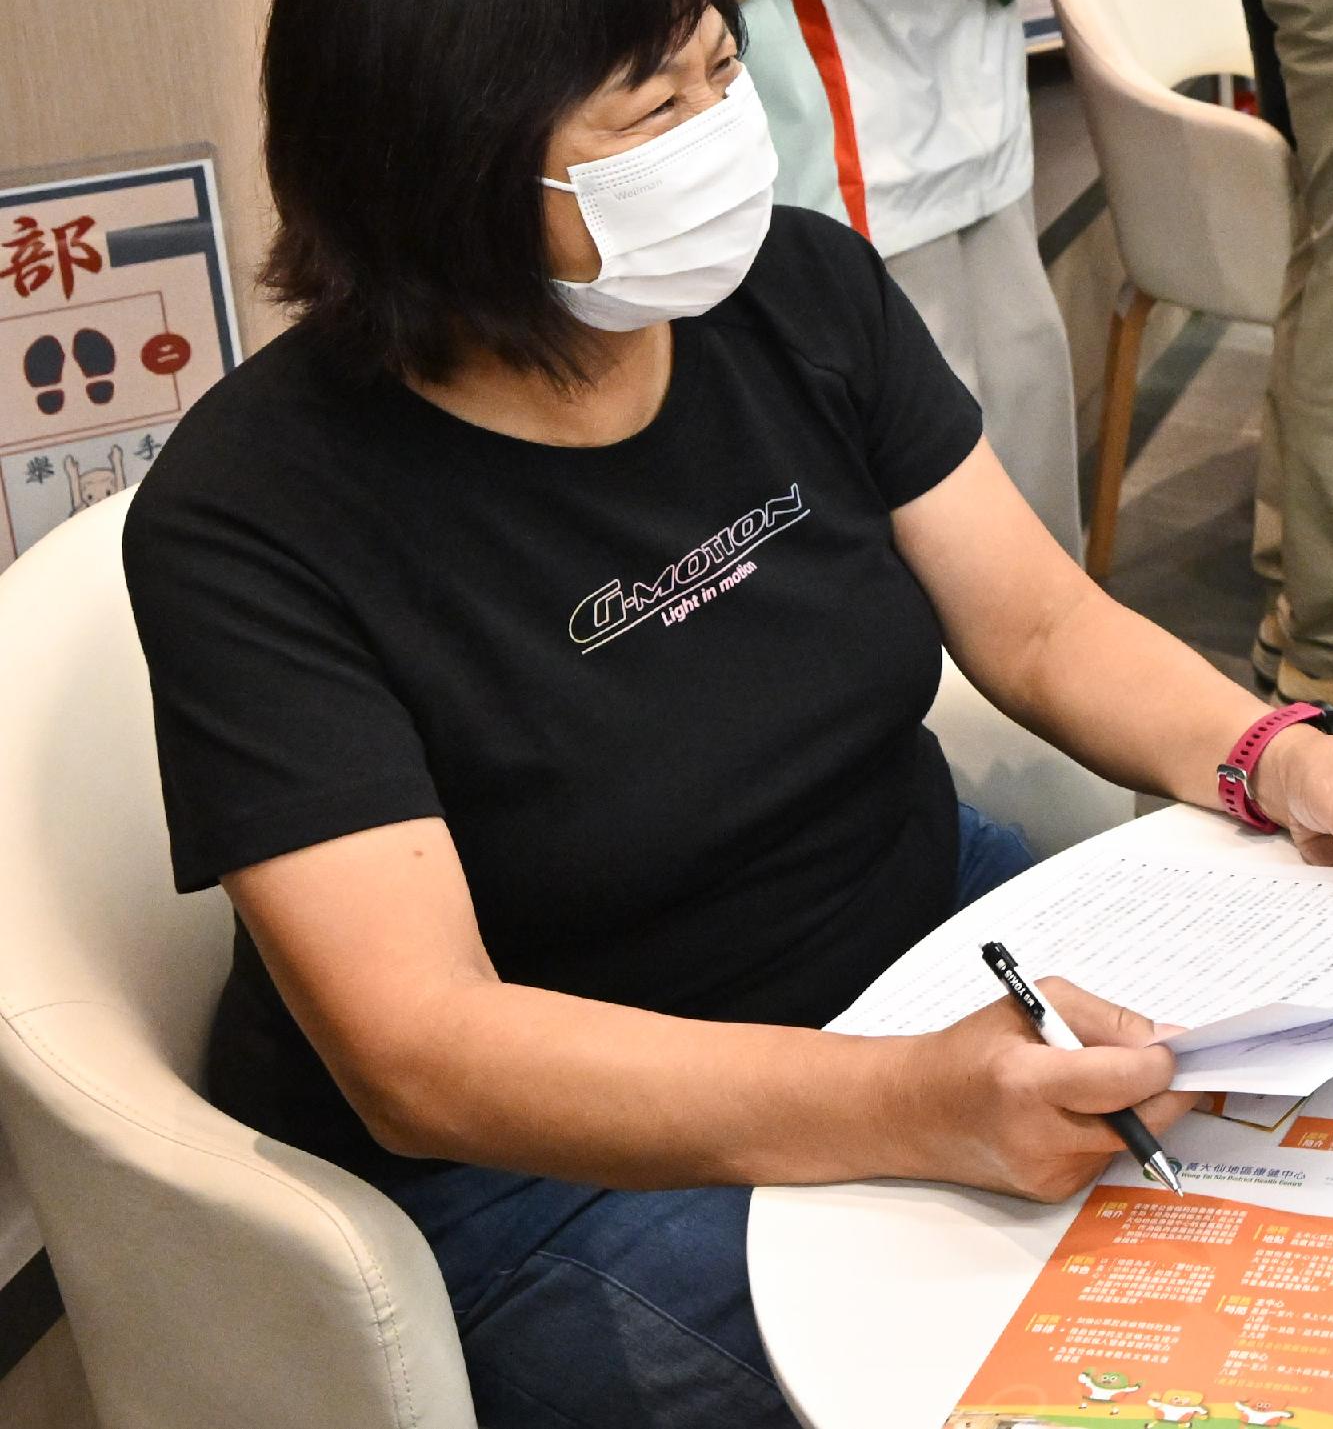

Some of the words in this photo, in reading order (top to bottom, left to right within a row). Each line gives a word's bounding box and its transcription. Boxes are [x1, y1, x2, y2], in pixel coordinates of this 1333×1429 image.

[0, 215, 105, 300] 部
[569, 483, 803, 644] G-MOTION
[661, 593, 701, 628] Light
[702, 585, 717, 604] in
[719, 559, 758, 595] motion
